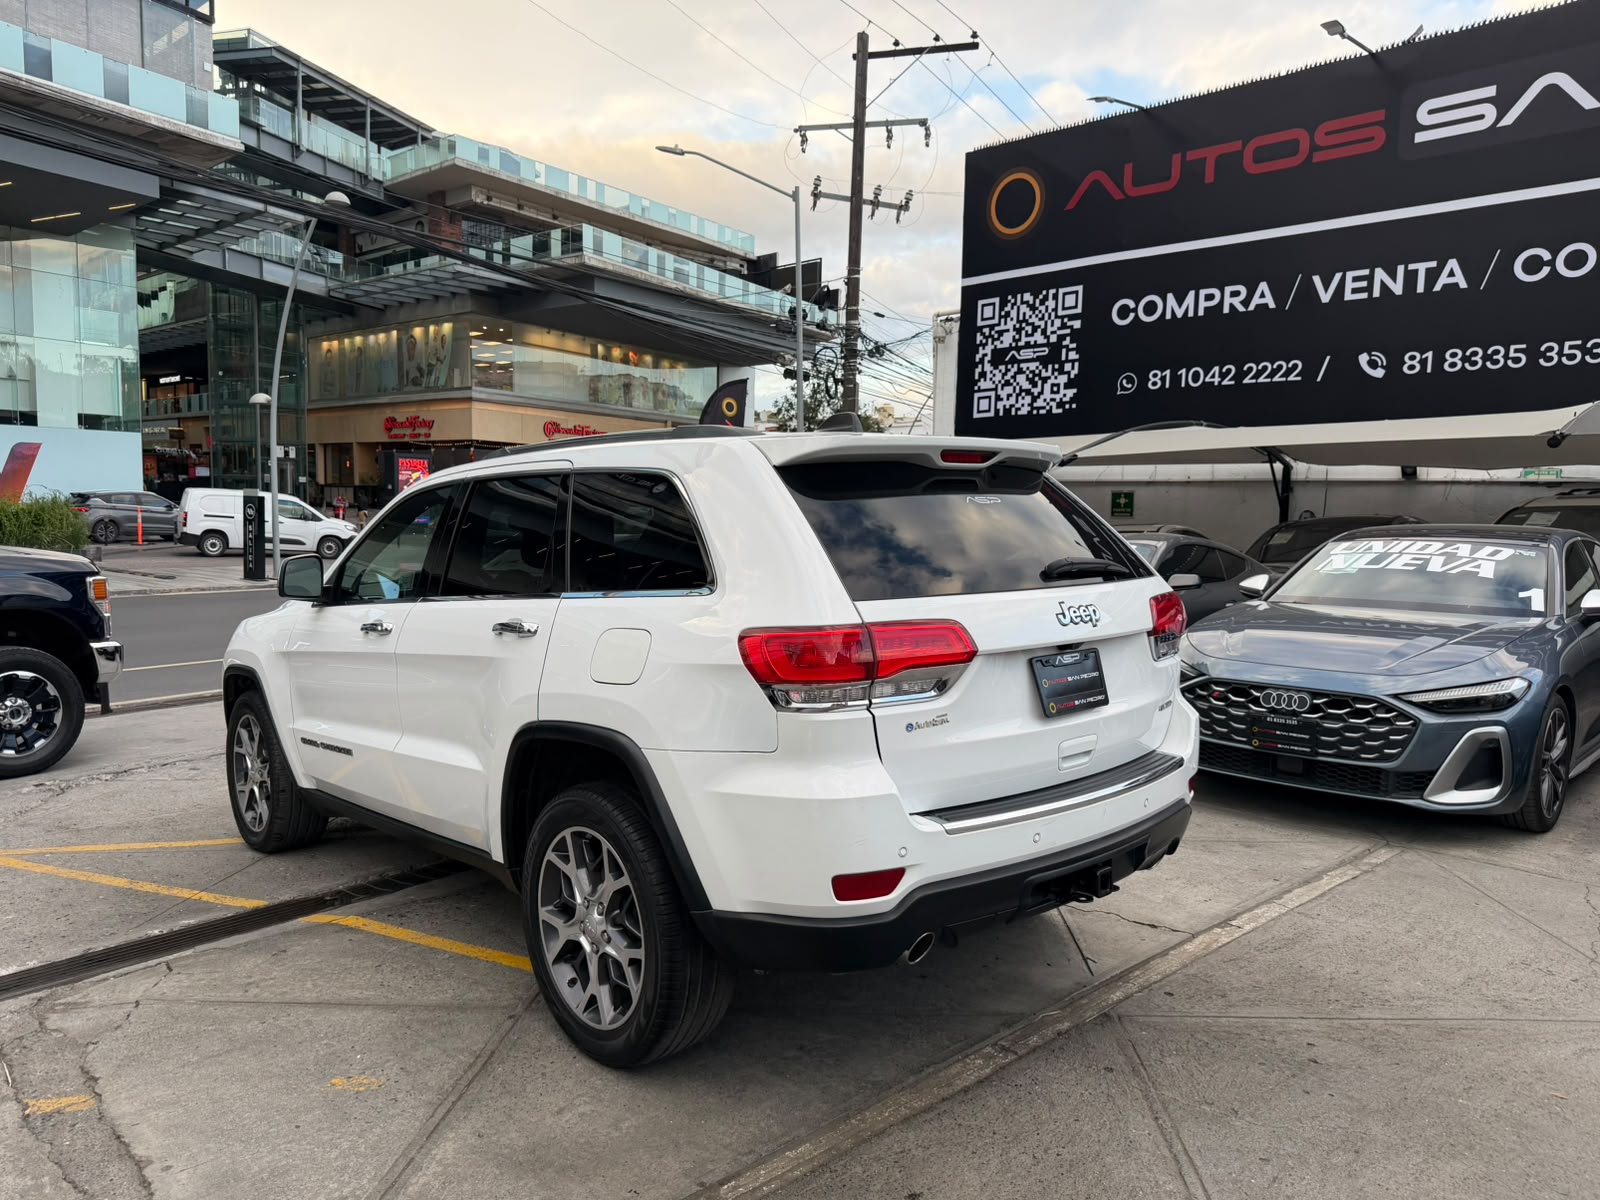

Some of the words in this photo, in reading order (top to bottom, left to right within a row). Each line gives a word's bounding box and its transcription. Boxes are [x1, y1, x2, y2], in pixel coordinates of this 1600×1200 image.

[1064, 109, 1386, 211] AUTOS
[1111, 281, 1277, 326] COMPRA
[1312, 258, 1468, 304] VENTA
[1513, 242, 1598, 283] CO
[1004, 347, 1049, 361] ASP
[1147, 369, 1171, 390] 81
[1177, 364, 1236, 388] 1042
[1242, 359, 1303, 384] 2222
[1402, 350, 1434, 375] 81
[1443, 343, 1527, 373] 8335
[966, 496, 1001, 504] ASP
[1329, 540, 1516, 561] UNIDAD
[1315, 553, 1496, 579] NUEVA
[1055, 600, 1101, 628] Jeep
[1055, 652, 1080, 665] ASP
[1067, 674, 1080, 682] SAN
[1080, 671, 1099, 679] PEDRO
[1074, 698, 1087, 706] SAN
[1087, 694, 1105, 703] PEDRO
